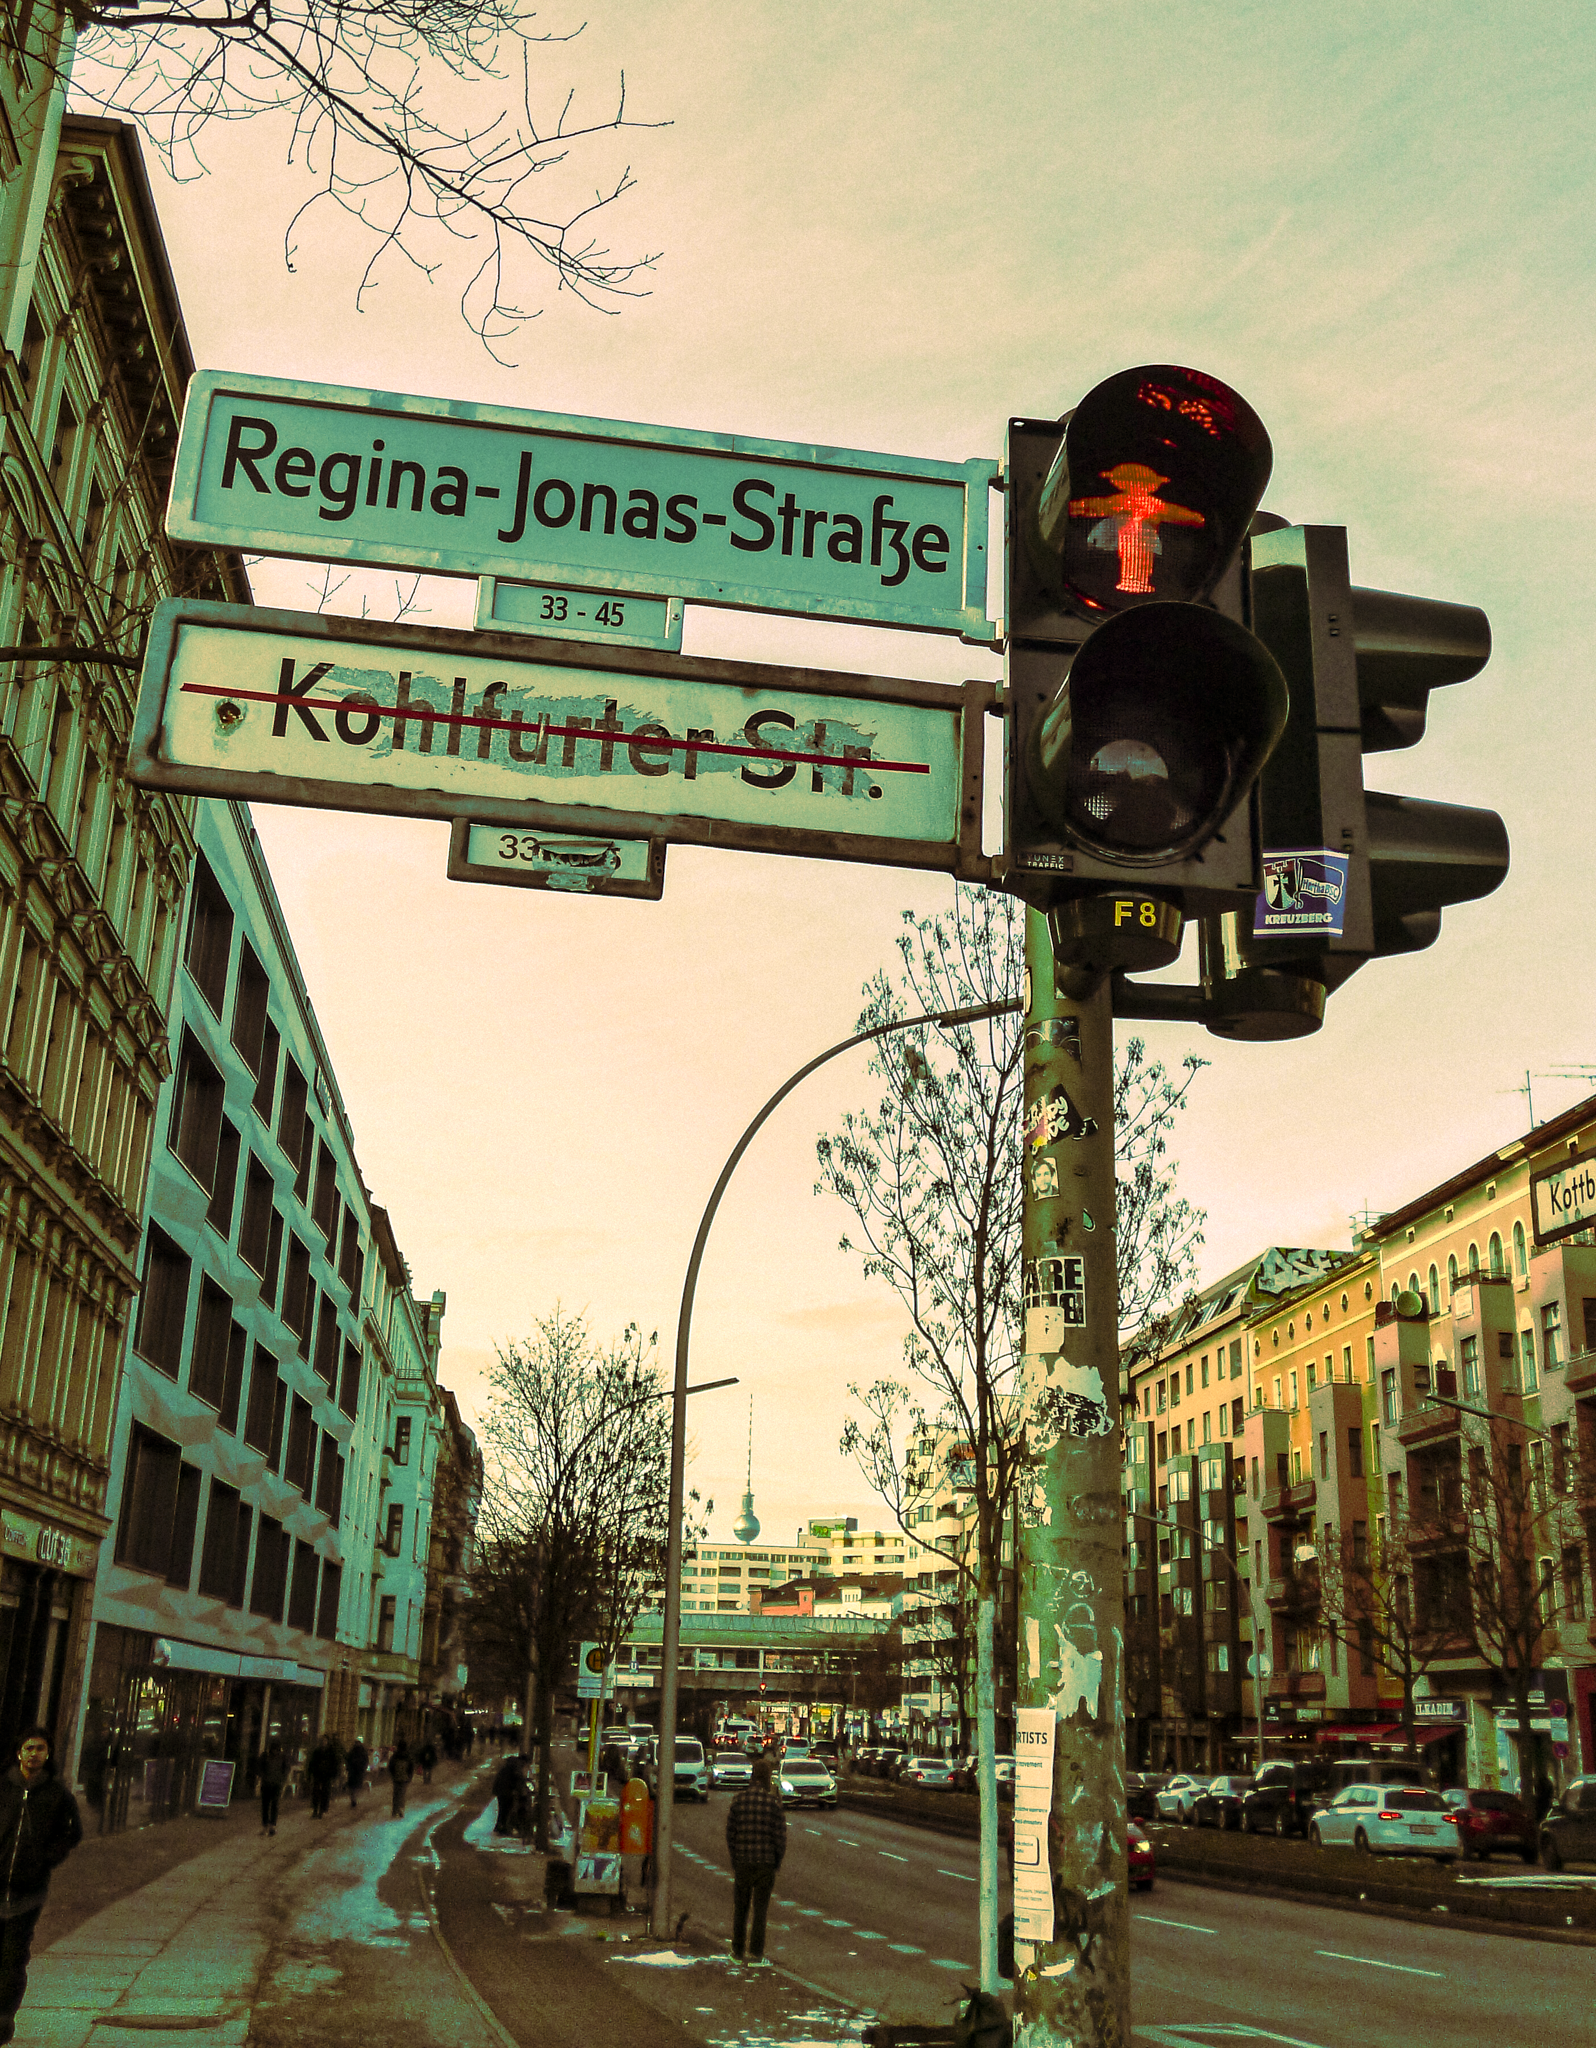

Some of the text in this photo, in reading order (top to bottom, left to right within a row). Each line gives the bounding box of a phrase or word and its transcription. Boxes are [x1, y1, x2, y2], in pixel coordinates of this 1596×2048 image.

[221, 414, 951, 586] Regina-Jonas-Straße
[540, 595, 568, 622] 33
[594, 601, 625, 628] 45
[271, 656, 884, 801] Kohlfurter Str.
[1026, 861, 1065, 870] TRAFFIC
[1264, 911, 1334, 926] KREUZBERG
